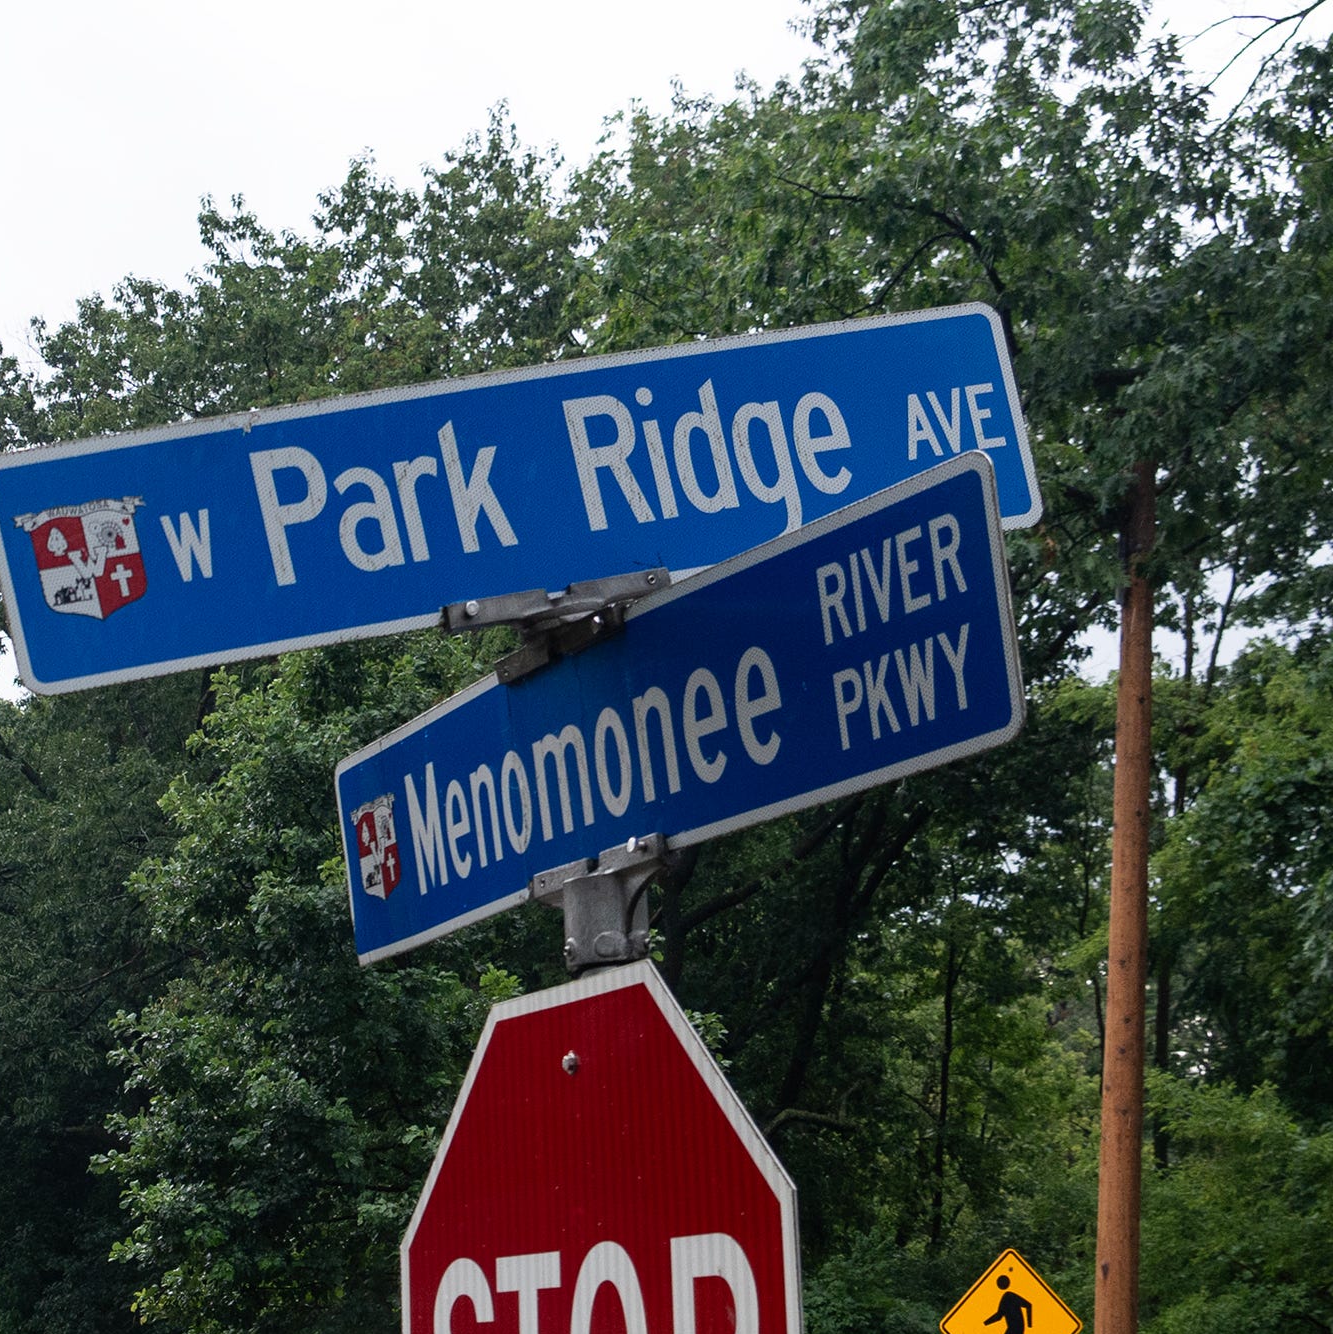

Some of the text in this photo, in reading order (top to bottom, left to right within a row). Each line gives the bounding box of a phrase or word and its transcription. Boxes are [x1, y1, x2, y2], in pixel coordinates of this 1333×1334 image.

[160, 377, 1008, 587] W Park Ridge AVE
[815, 513, 970, 647] RIVER
[404, 645, 783, 897] Menomonee
[832, 623, 973, 752] PKWY
